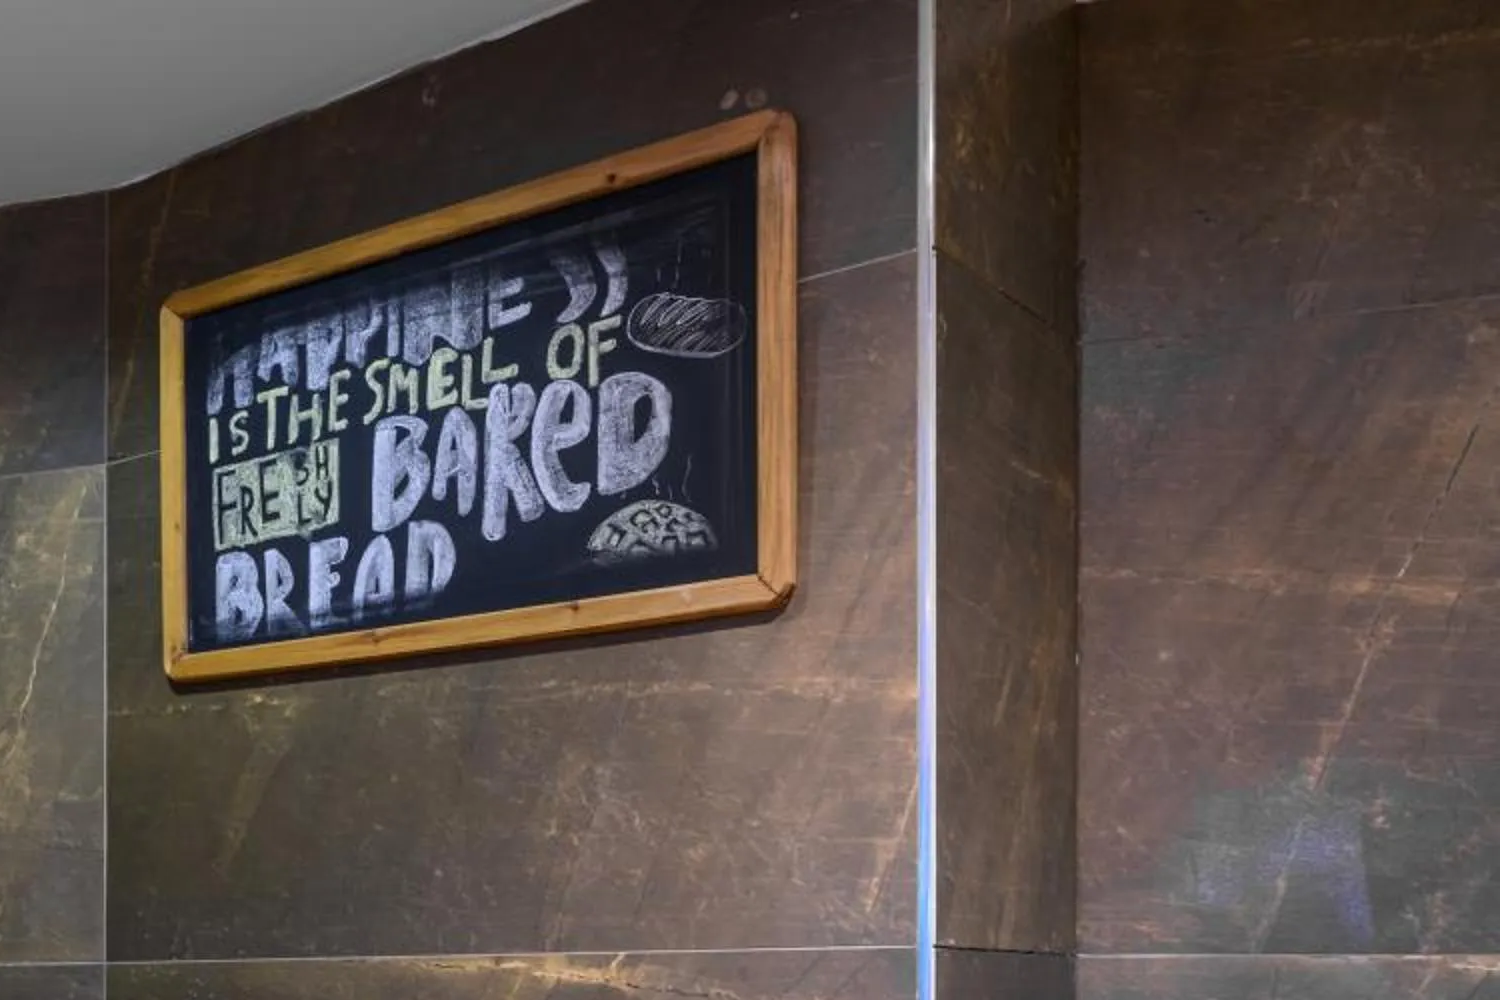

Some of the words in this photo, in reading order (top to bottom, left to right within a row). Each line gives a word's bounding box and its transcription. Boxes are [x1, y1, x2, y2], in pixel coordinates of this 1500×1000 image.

[209, 410, 249, 464] IS
[257, 369, 351, 450] THE
[363, 337, 519, 425] SMELL
[547, 315, 623, 387] OF
